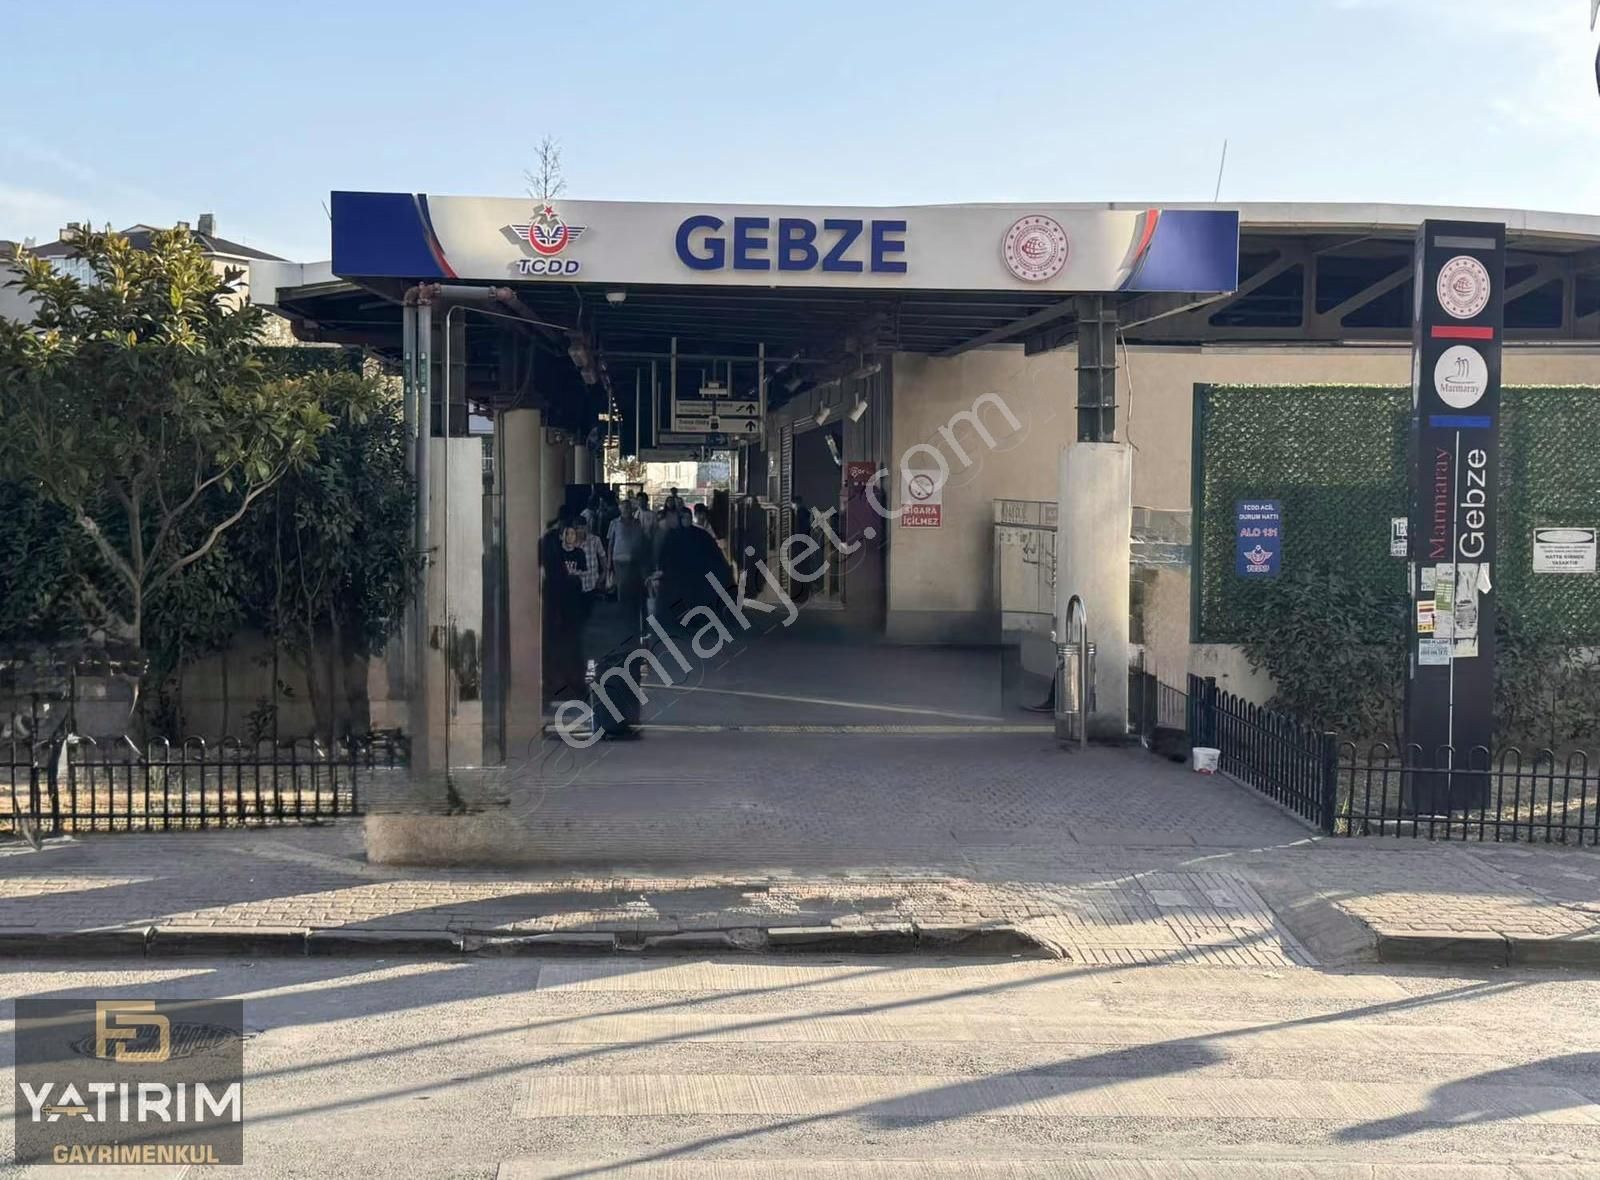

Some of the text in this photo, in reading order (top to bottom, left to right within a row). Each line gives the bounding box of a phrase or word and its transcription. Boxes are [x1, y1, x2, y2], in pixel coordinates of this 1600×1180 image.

[675, 214, 908, 274] GEBZE
[517, 258, 581, 276] TCDD
[1440, 383, 1480, 395] Marmaray
[1429, 447, 1453, 560] Marmaray
[1459, 448, 1488, 558] Gebze
[1240, 527, 1261, 537] ALO
